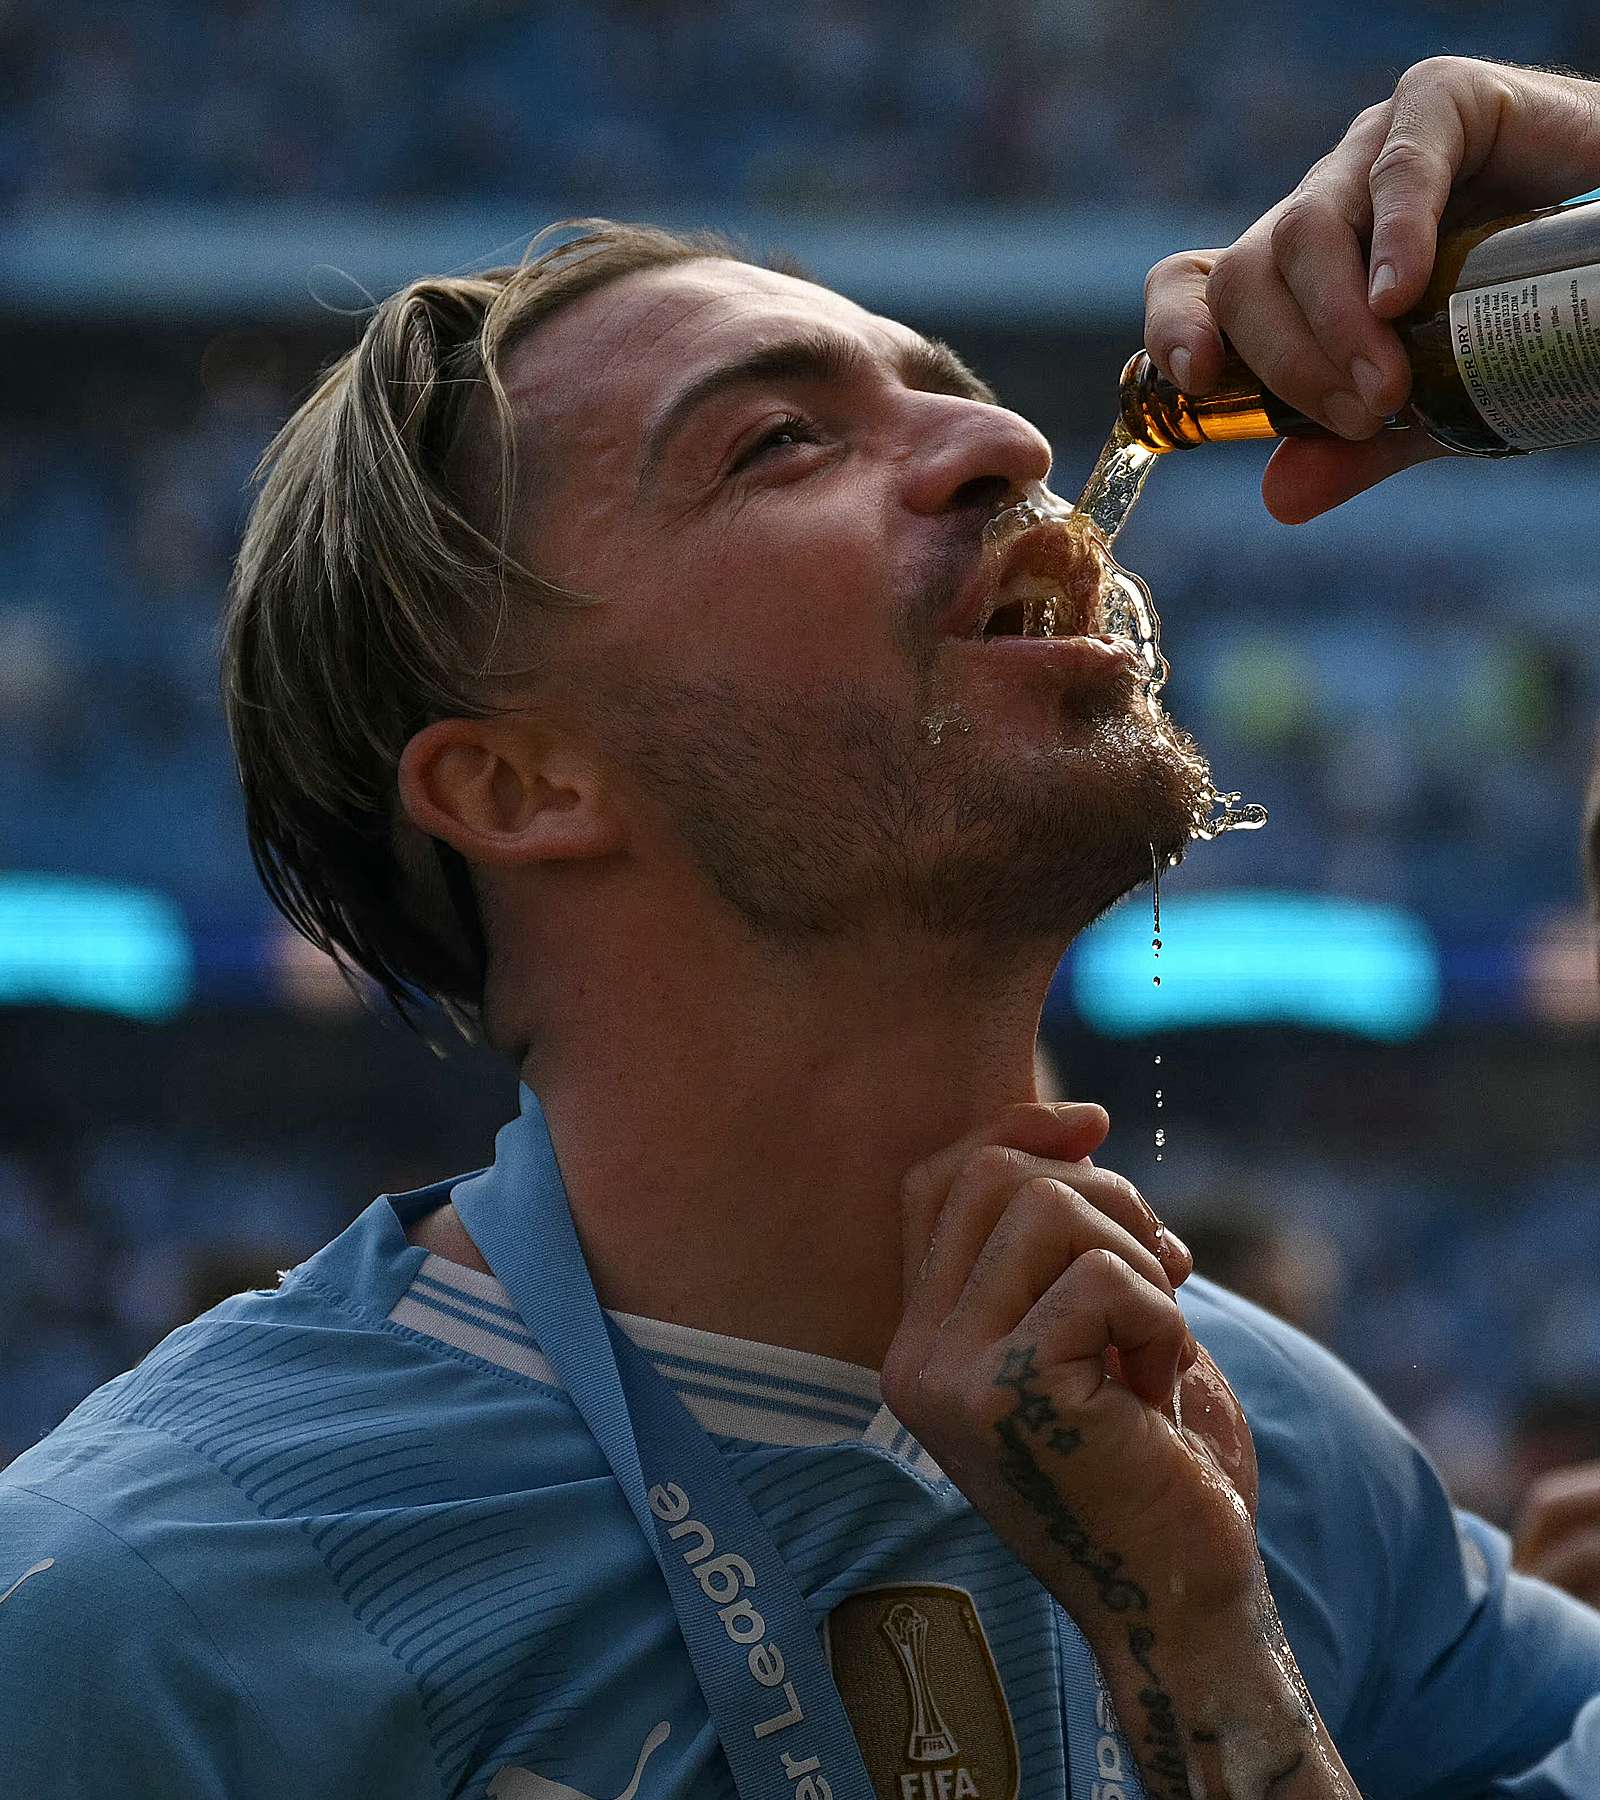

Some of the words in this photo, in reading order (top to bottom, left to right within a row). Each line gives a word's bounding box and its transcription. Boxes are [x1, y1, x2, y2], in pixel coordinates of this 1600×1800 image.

[1457, 324, 1471, 355] DRY
[1464, 360, 1491, 406] SUPER
[1486, 409, 1520, 438] ASAHI
[648, 1480, 804, 1738] League
[901, 1768, 981, 1800] FIFA
